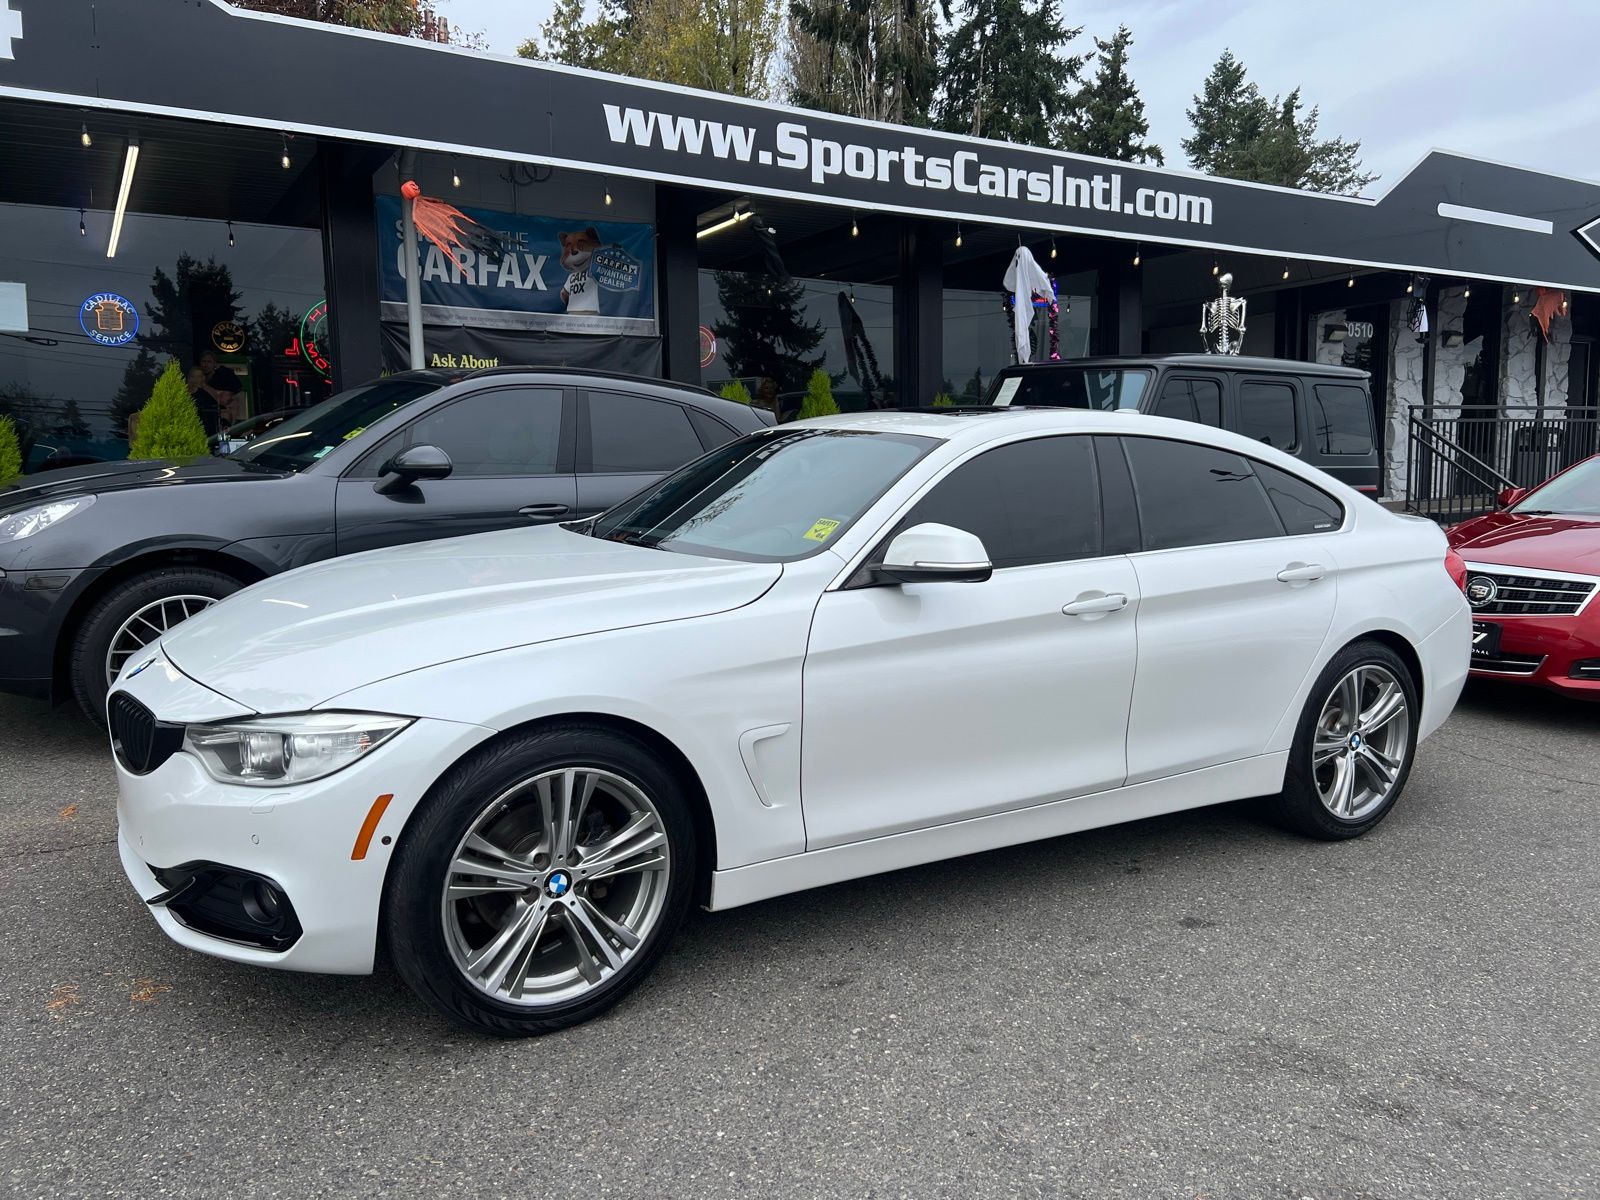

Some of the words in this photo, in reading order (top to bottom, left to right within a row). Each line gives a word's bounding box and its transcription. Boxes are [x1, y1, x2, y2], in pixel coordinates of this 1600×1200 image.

[602, 103, 1213, 225] www.SportsCarsIntl.com
[596, 255, 638, 275] CARFAX
[569, 271, 588, 284] CAR
[596, 267, 633, 283] ADVANTAGE
[600, 276, 625, 289] DEALER
[569, 282, 586, 296] FOX
[84, 294, 135, 314] CADILLAC
[90, 329, 131, 344] SERVICE
[430, 353, 457, 368] Ask
[460, 354, 498, 369] About
